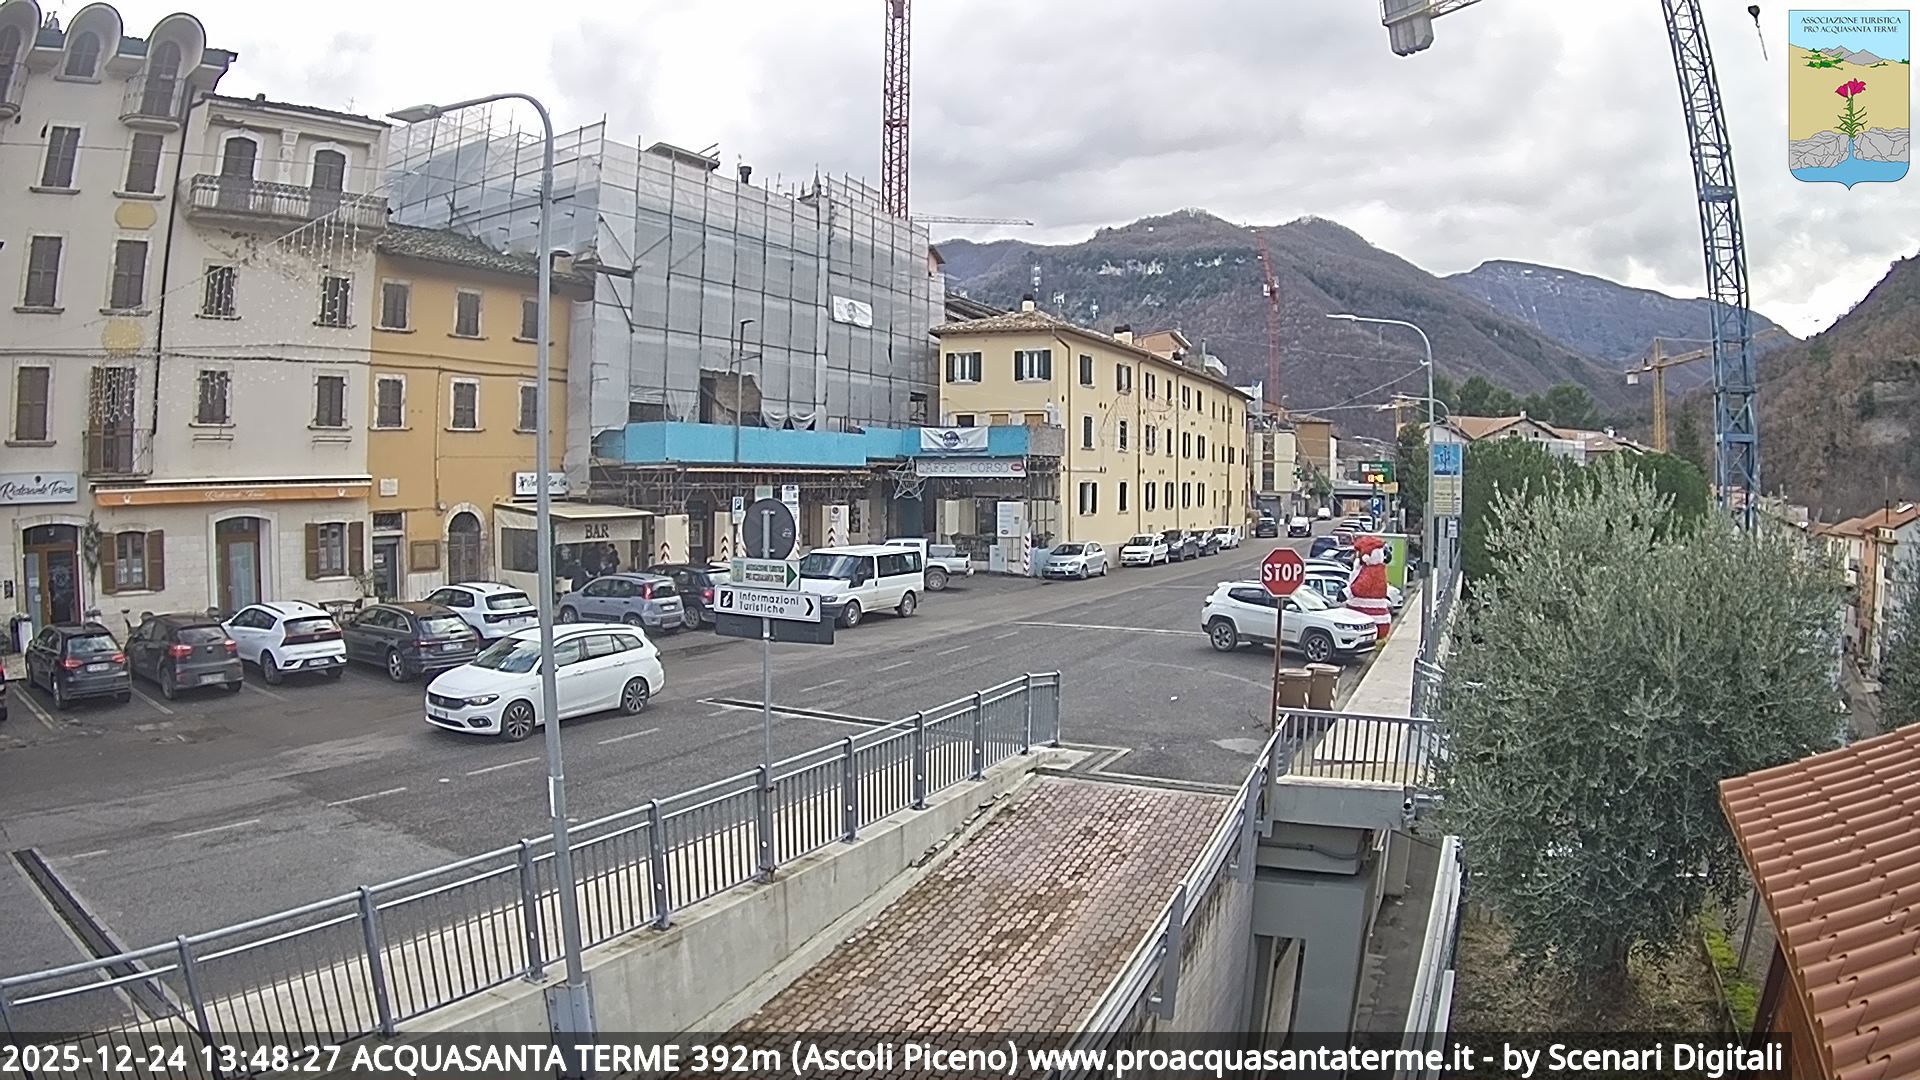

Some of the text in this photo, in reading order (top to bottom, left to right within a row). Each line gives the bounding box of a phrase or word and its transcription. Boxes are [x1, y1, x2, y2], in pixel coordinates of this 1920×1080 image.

[970, 462, 1009, 473] CORSO
[584, 523, 609, 539] BAR
[1263, 563, 1302, 582] STOP
[739, 592, 799, 606] Informazioni
[739, 600, 785, 614] Turistiche
